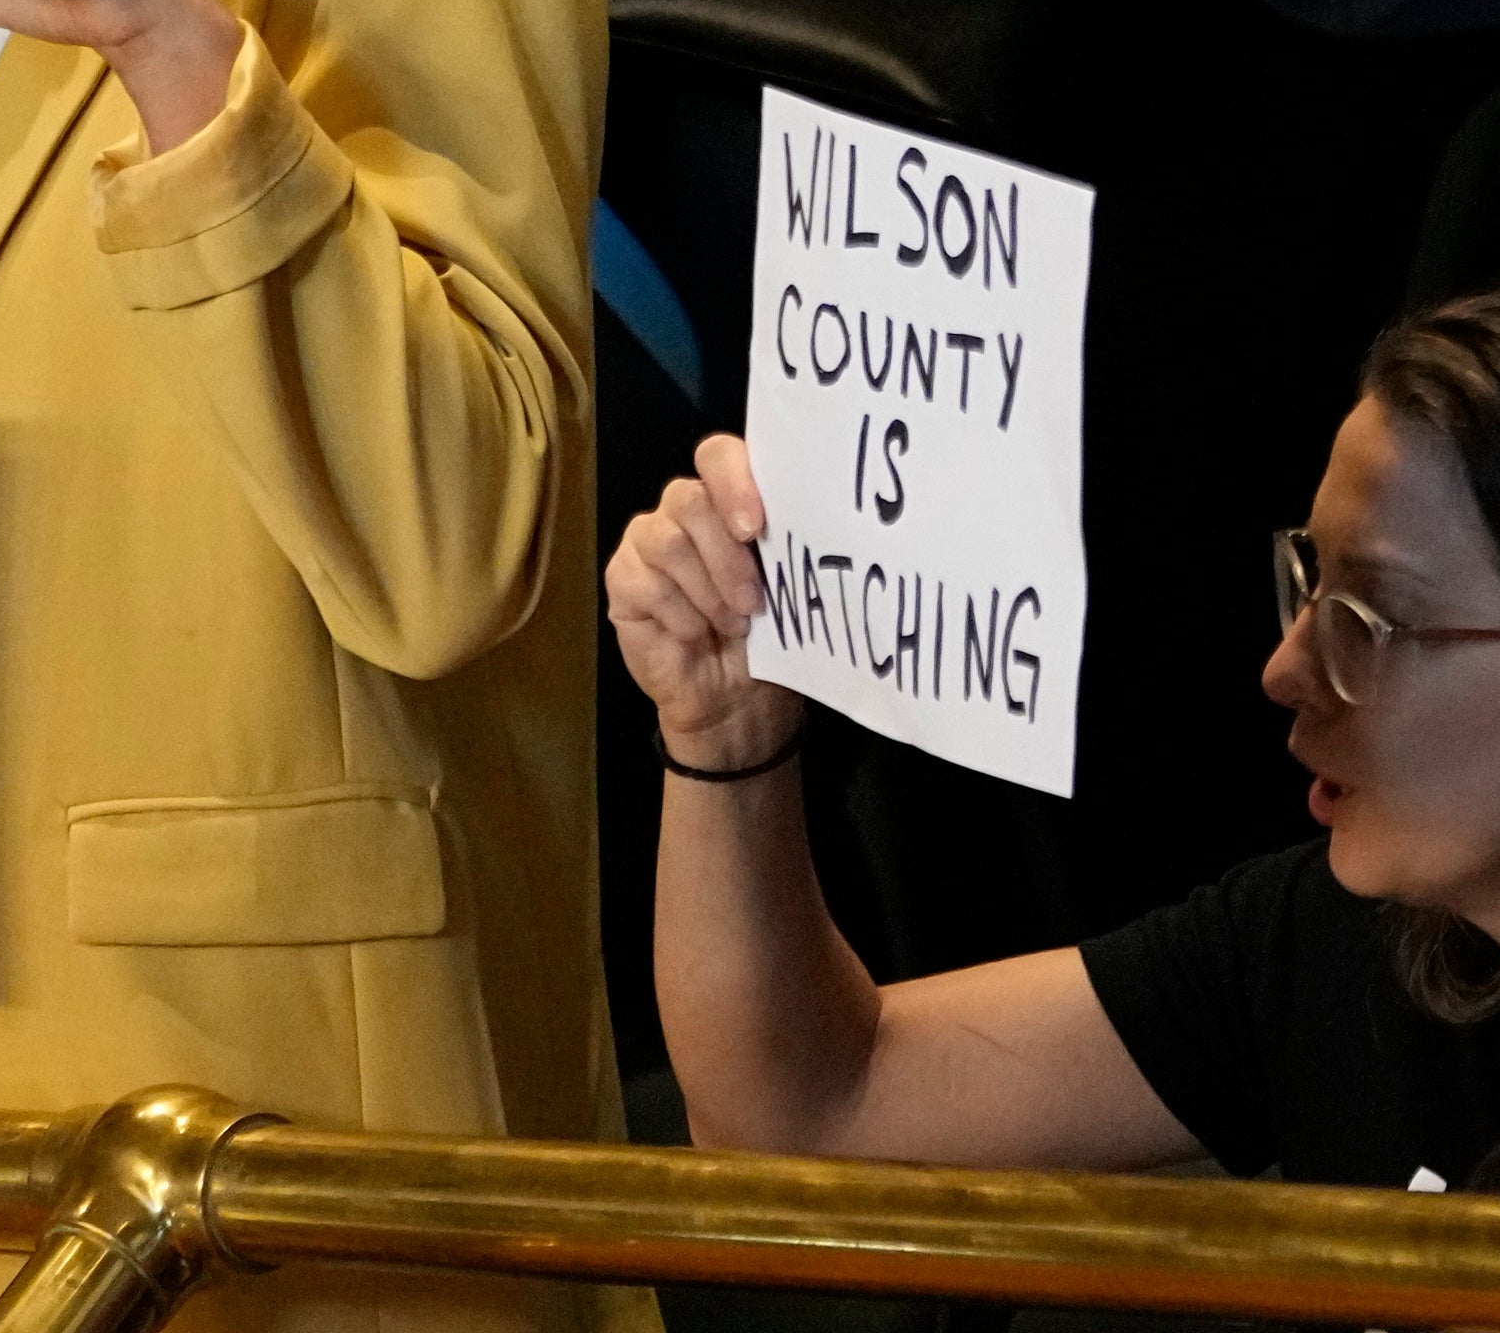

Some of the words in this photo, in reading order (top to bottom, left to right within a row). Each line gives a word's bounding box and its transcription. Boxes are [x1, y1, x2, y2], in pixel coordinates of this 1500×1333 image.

[783, 126, 1019, 291] WILSON
[776, 284, 1024, 432] COUNTY
[854, 413, 909, 526] IS
[763, 531, 1041, 725] WATCHING
